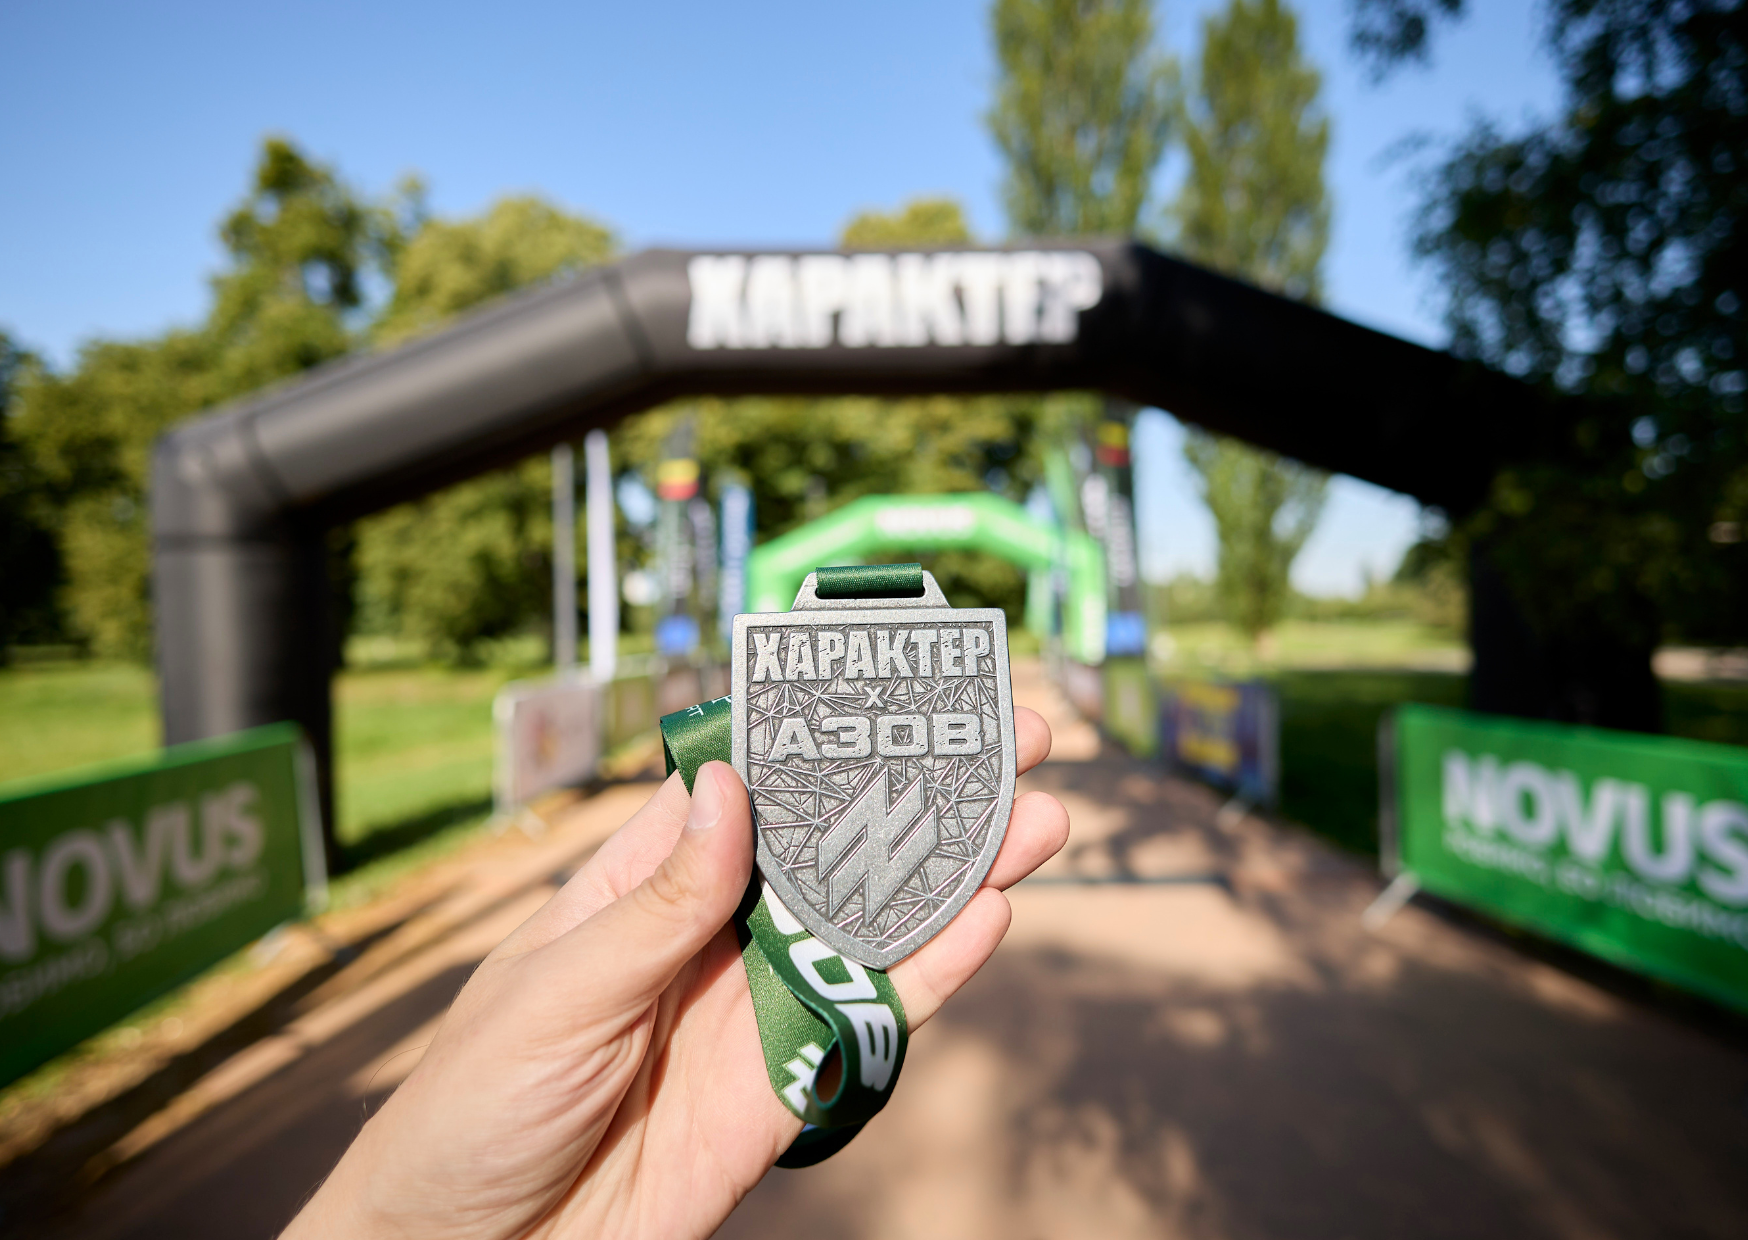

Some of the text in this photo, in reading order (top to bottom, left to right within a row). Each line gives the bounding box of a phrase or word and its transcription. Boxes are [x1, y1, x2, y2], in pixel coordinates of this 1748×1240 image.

[687, 251, 1103, 349] ХАРАКТЕР
[752, 628, 990, 683] ХАРАКТЕР
[769, 714, 982, 762] АЗОВ
[1441, 746, 1748, 905] NOVUS
